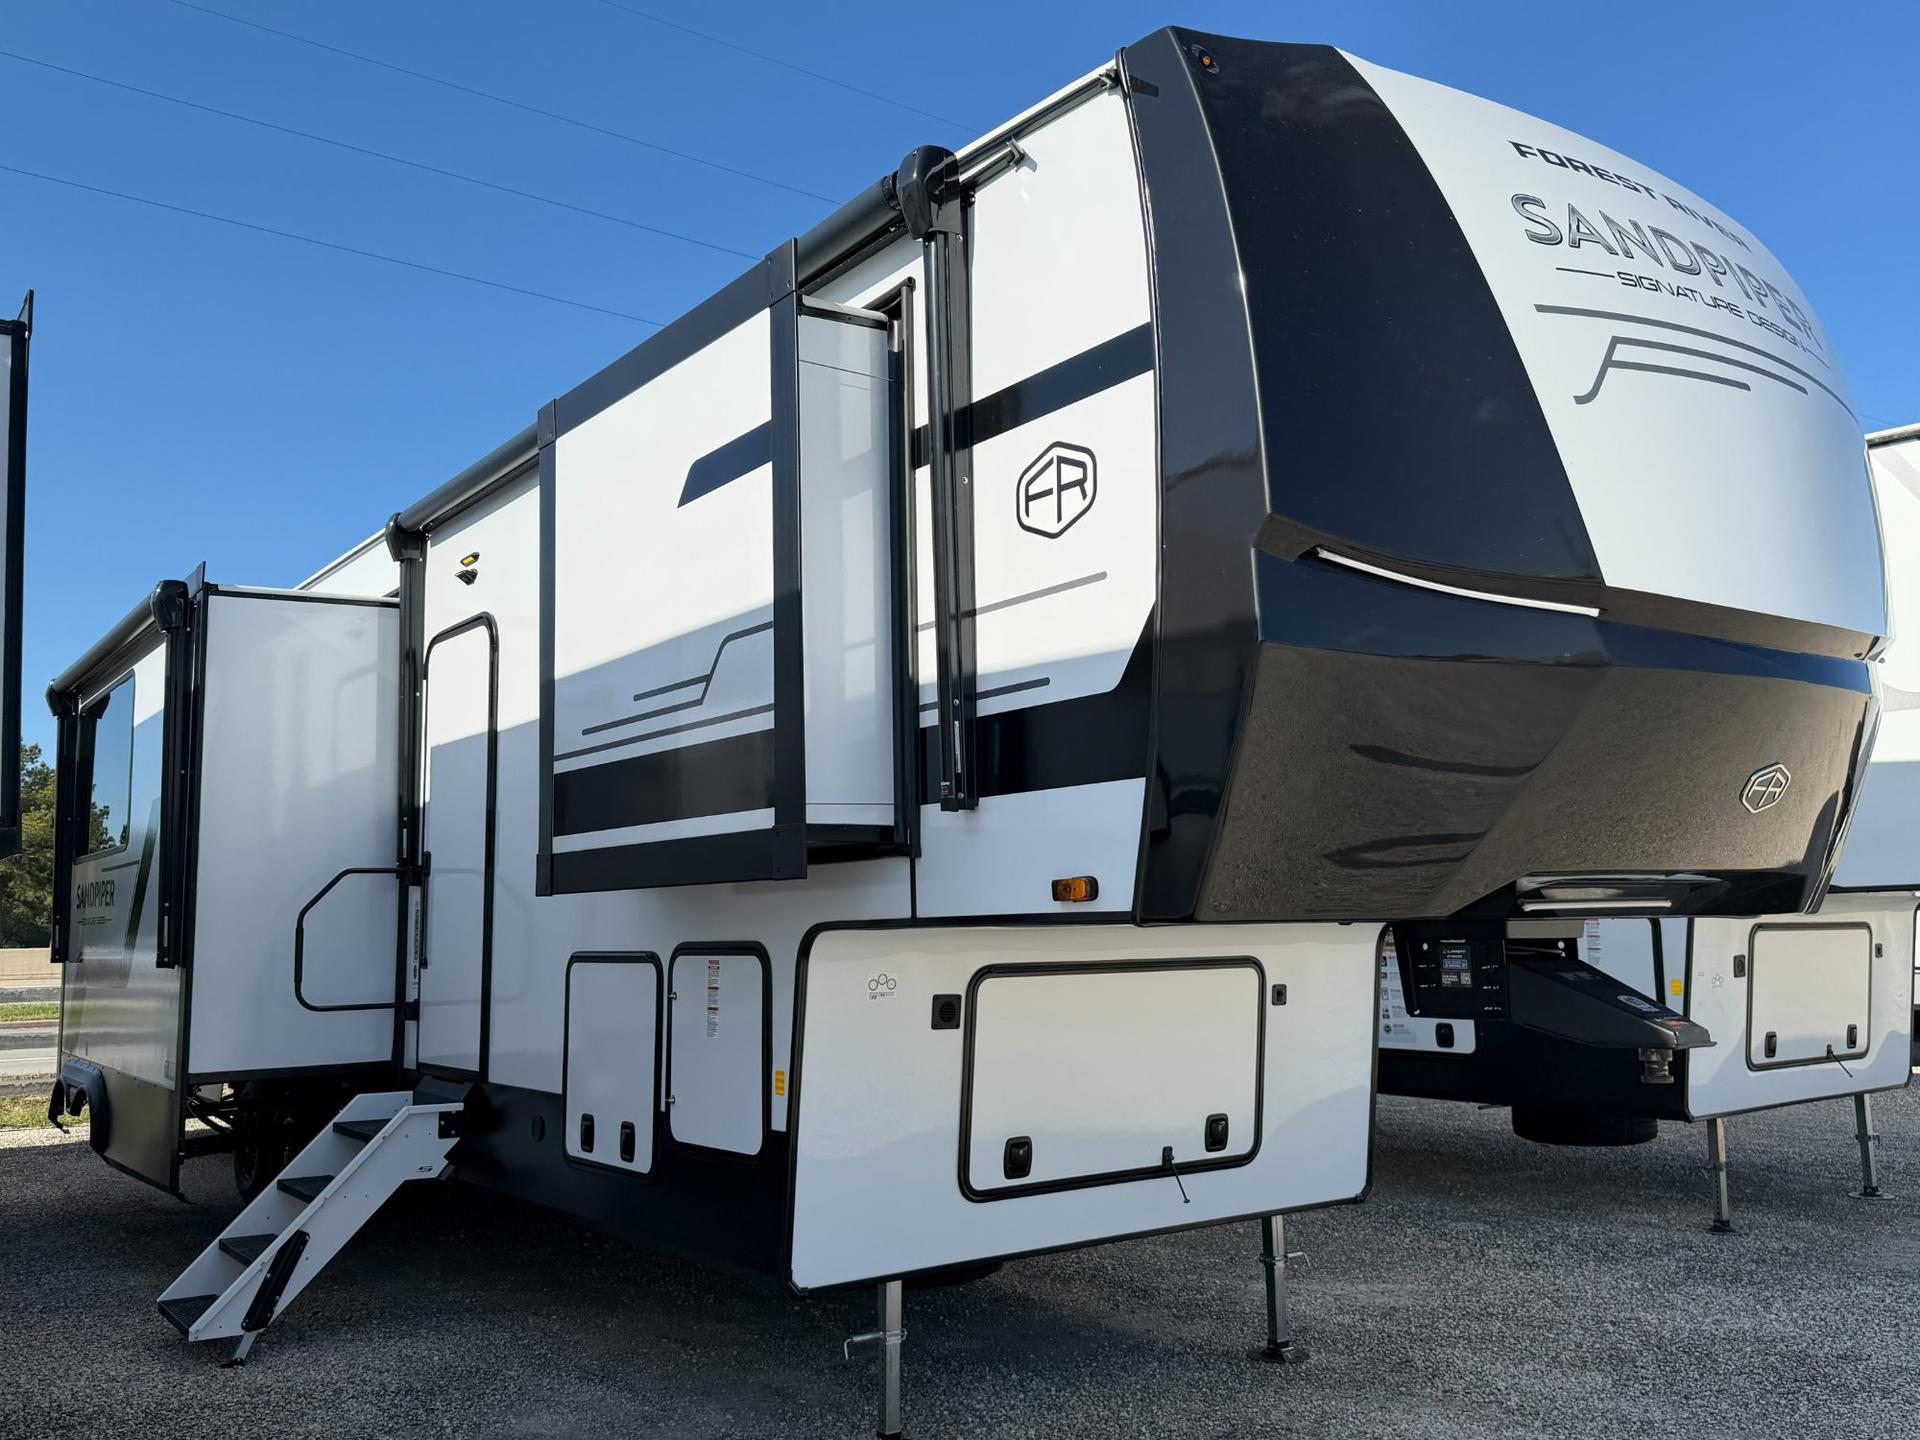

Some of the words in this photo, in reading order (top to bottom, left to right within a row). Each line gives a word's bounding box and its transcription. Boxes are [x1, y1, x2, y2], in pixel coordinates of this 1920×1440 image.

[1507, 140, 1658, 200] FOREST
[1661, 193, 1752, 254] RIVER
[1510, 193, 1823, 352] SANDPIPER
[1616, 271, 1745, 319] SIGNATURE
[1746, 310, 1807, 353] DESIGN
[76, 880, 115, 910] SANDPIPER
